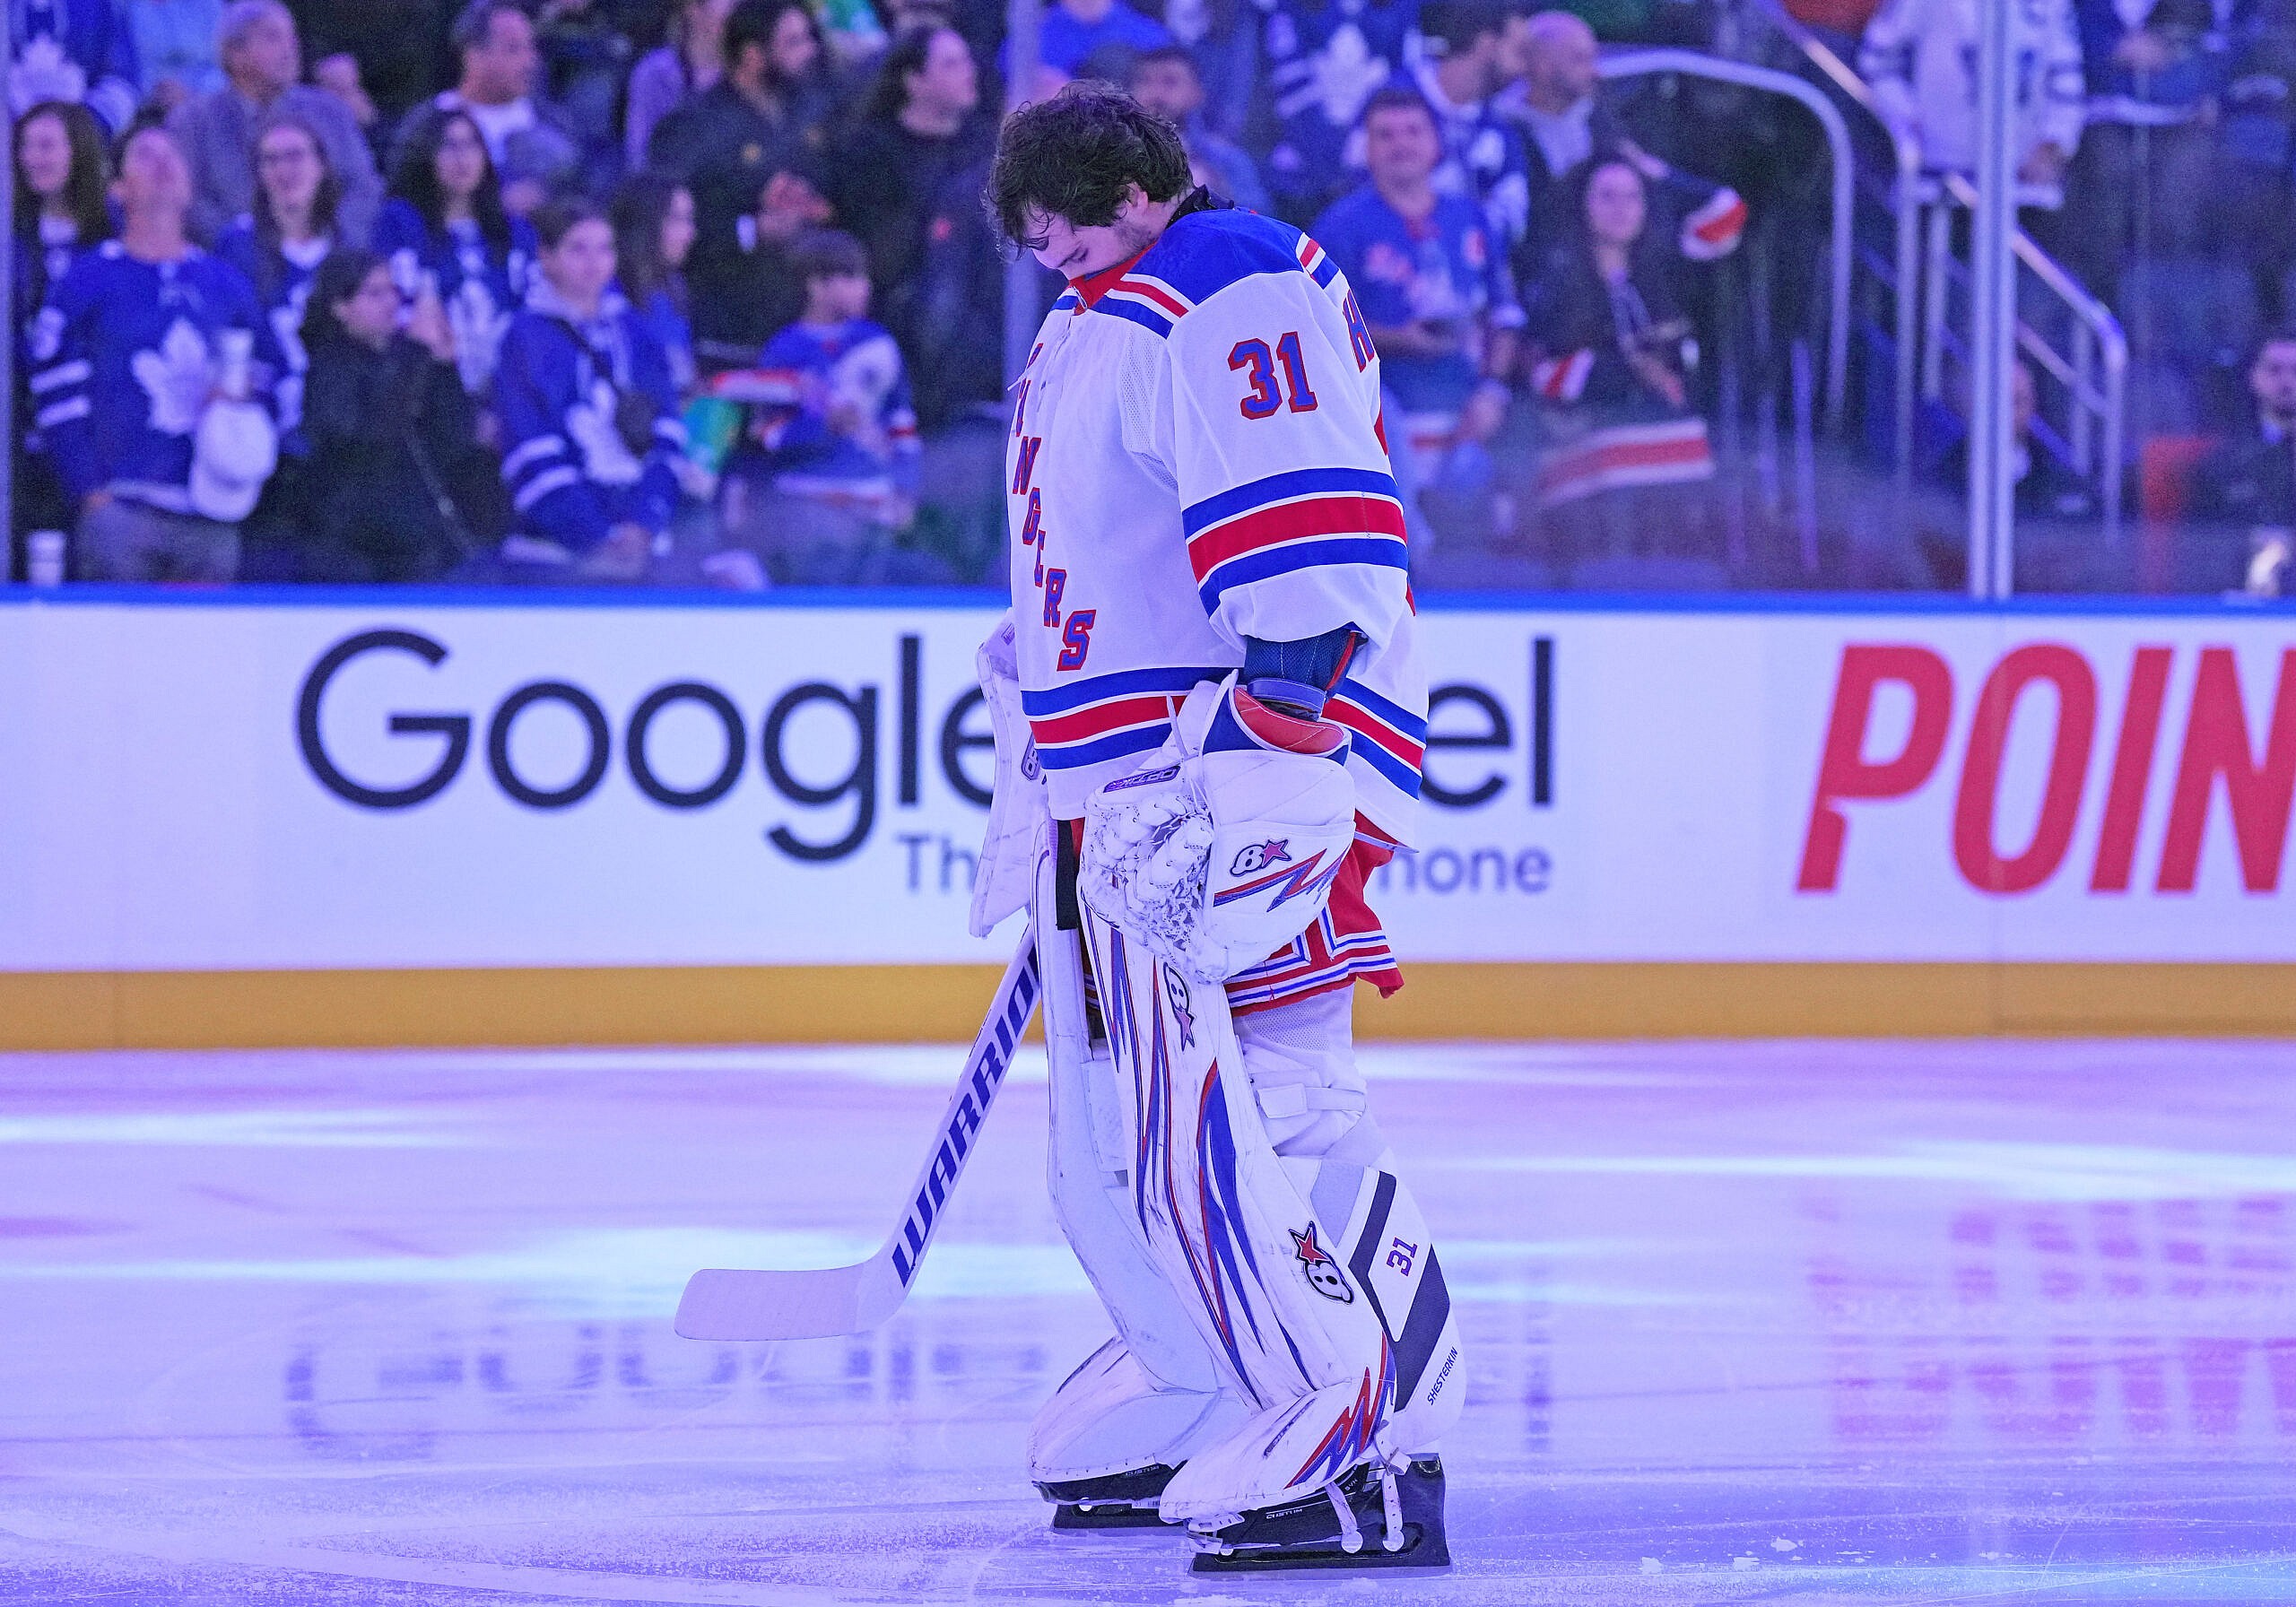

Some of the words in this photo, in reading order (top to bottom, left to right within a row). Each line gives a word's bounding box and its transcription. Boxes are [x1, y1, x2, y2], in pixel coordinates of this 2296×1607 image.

[1227, 331, 1318, 421] 31
[895, 833, 979, 892] Th
[1386, 1237, 1418, 1277] 31
[1427, 1346, 1458, 1406] SHESTERKIN
